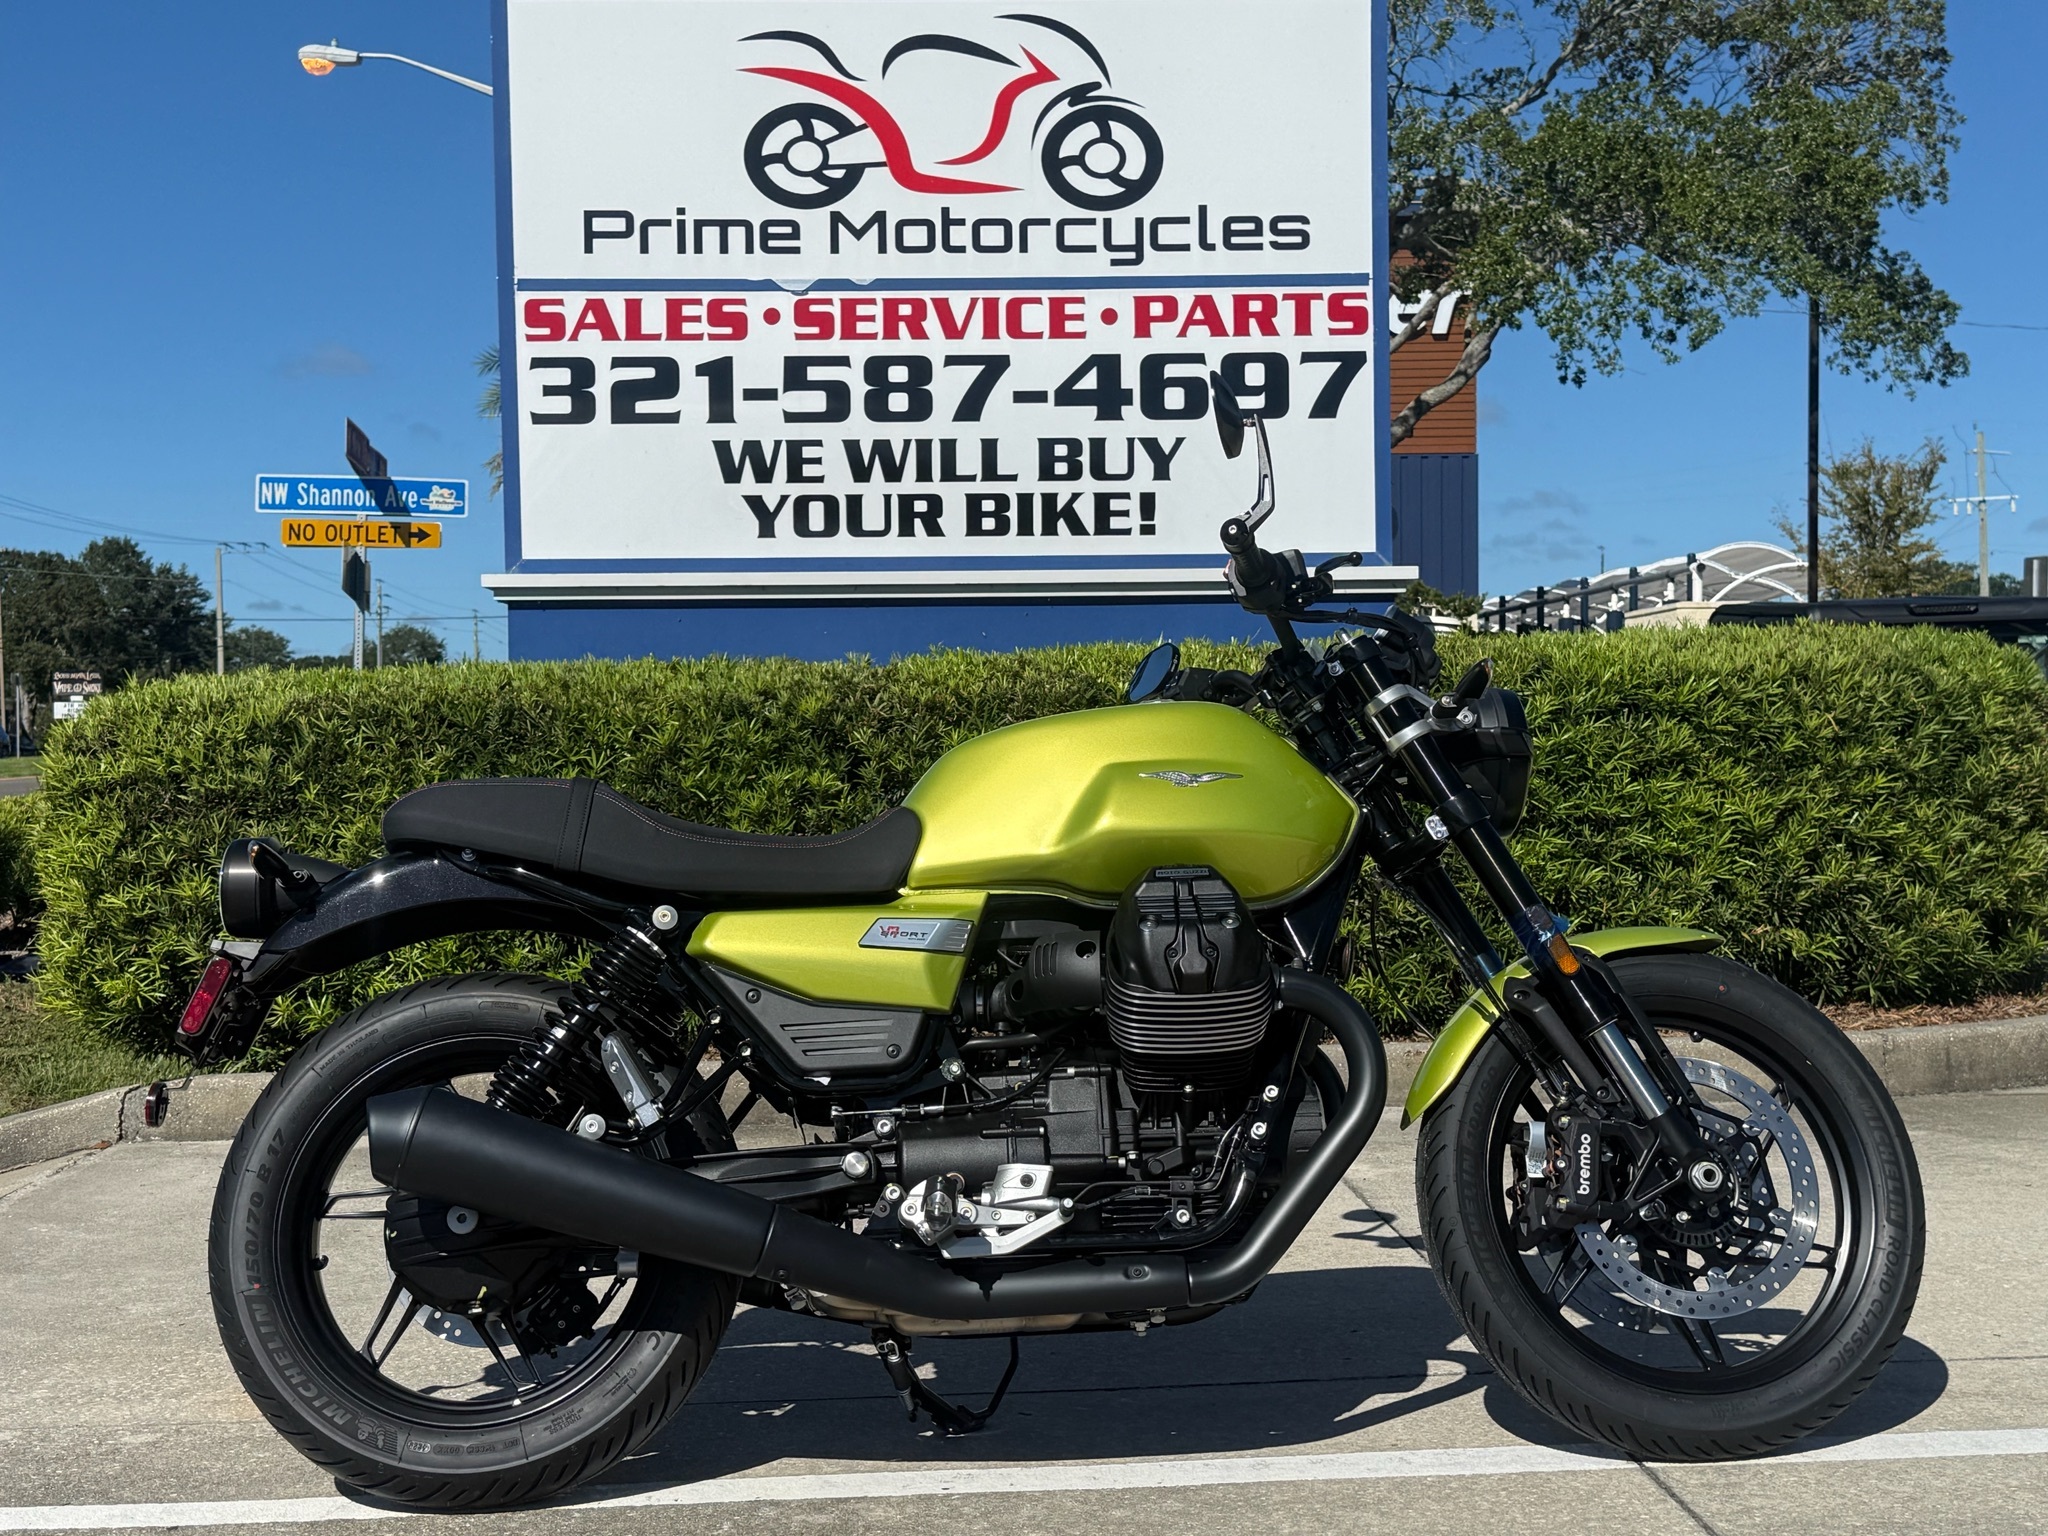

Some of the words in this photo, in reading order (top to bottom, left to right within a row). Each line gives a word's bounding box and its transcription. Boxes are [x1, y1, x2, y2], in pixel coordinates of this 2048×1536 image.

[584, 208, 801, 254] Prime
[829, 205, 1311, 266] Motorcycles
[524, 298, 748, 342] SALES
[793, 296, 1087, 341] SERVICE
[1133, 292, 1369, 338] PARTS
[529, 350, 1368, 426] 321-587-4697
[712, 440, 825, 484] WE
[842, 438, 1019, 484] WILL
[1037, 436, 1187, 482] BUY
[261, 482, 288, 505] NW
[297, 482, 376, 507] Shannon
[385, 485, 418, 509] Ave
[741, 493, 946, 539] YOUR
[964, 491, 1156, 537] BIKE!
[288, 523, 316, 542] NO
[325, 524, 402, 543] OUTLET
[1577, 1133, 1591, 1195] brembo
[1860, 1101, 1906, 1225] MICHELIN
[1878, 1233, 1902, 1296] ROAD
[252, 1303, 353, 1426] MICHELIN
[1828, 1299, 1885, 1372] CLASSIC
